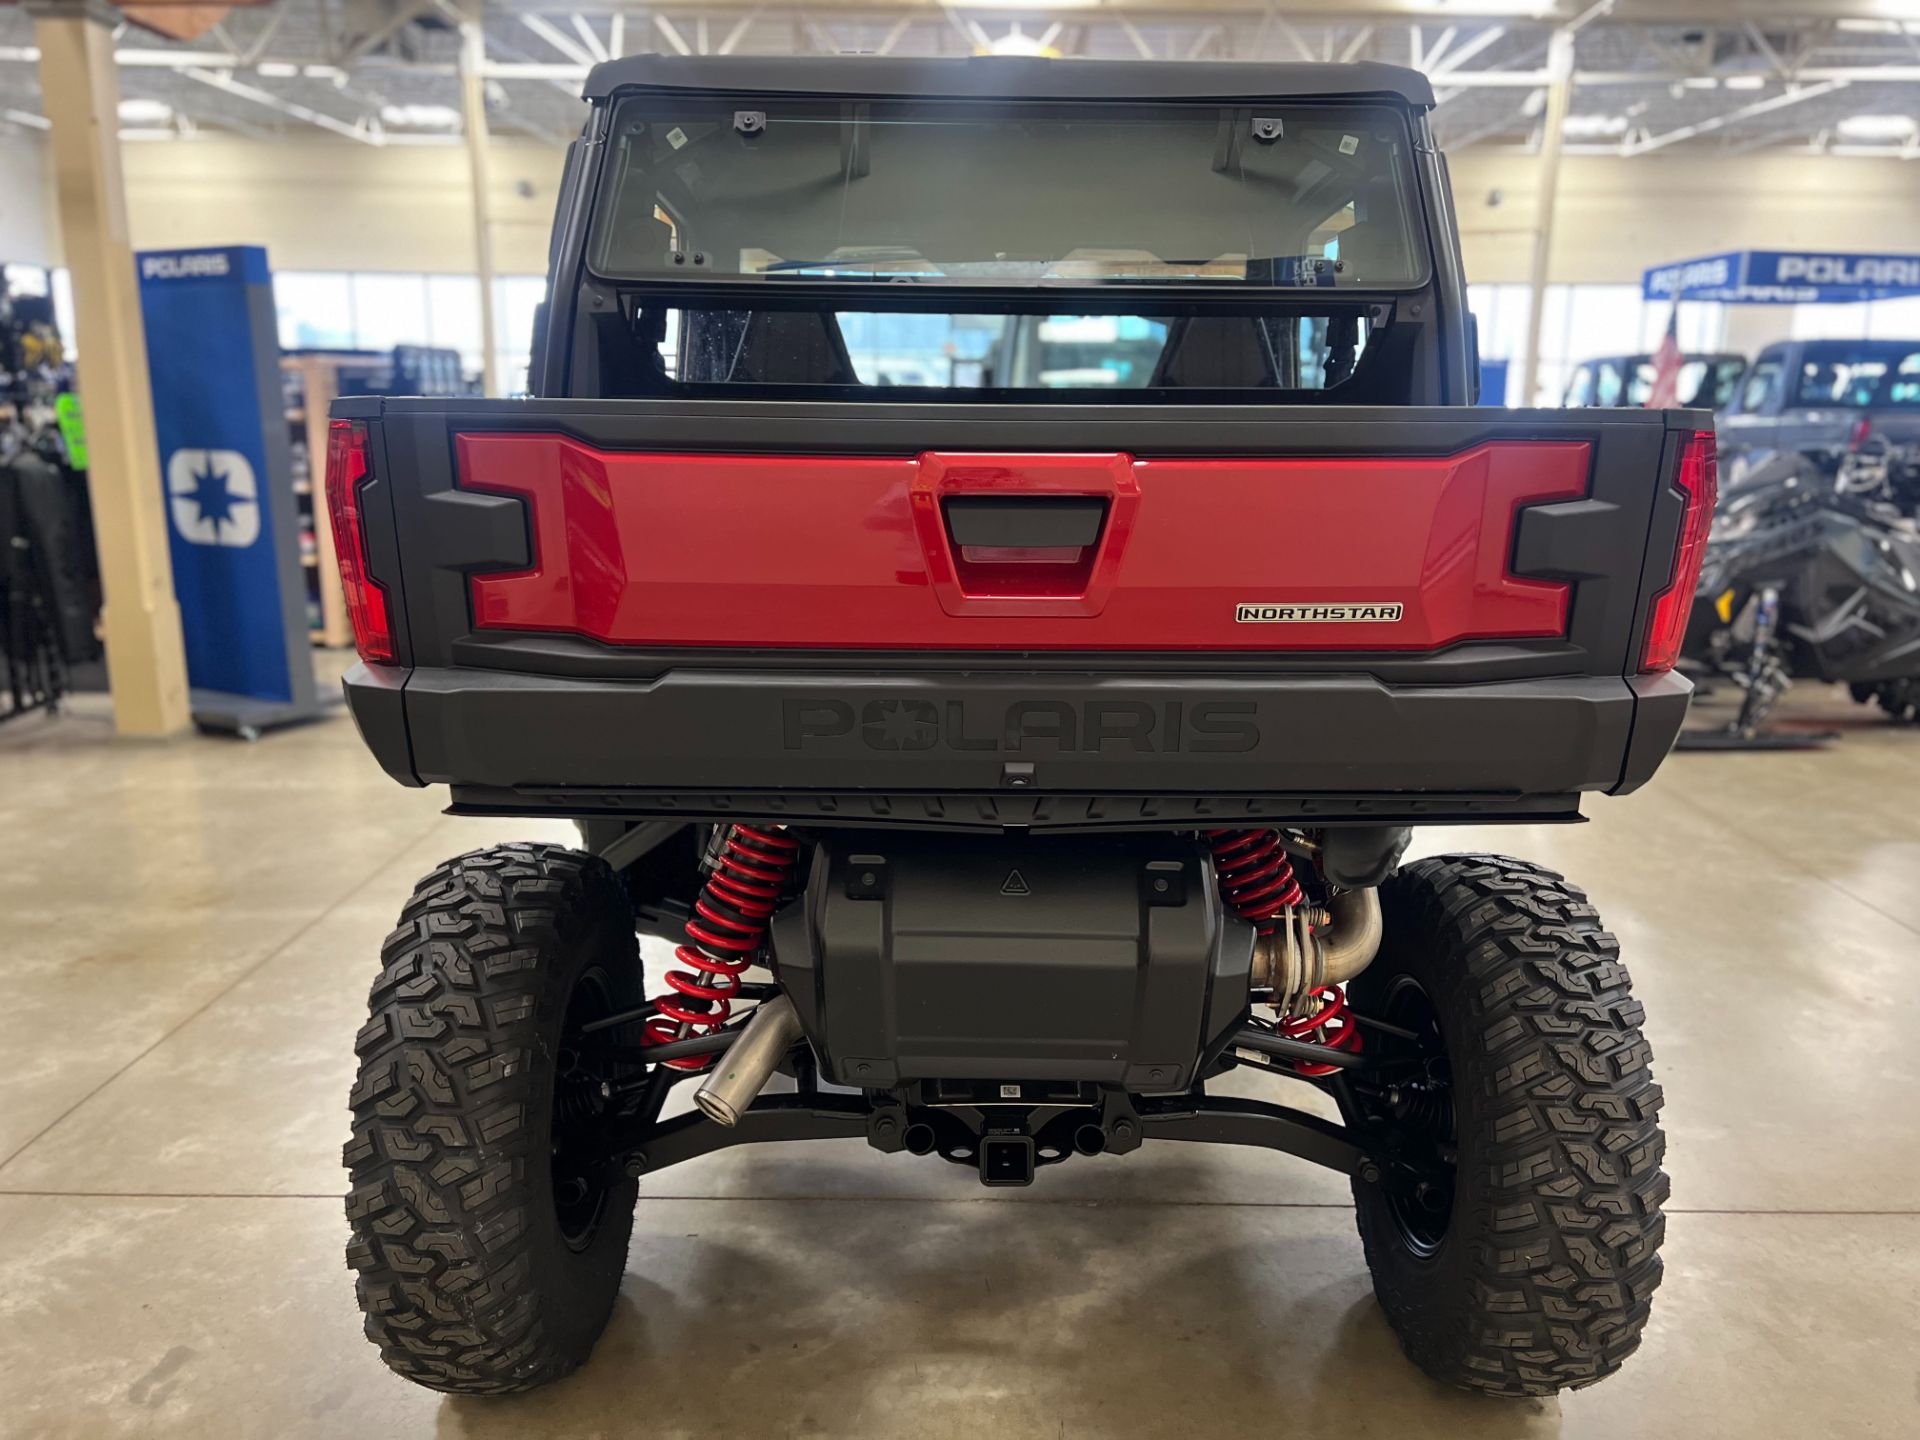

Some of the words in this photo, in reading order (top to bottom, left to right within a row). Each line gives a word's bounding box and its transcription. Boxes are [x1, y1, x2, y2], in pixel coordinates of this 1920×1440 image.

[143, 253, 229, 279] POLARIS
[1243, 607, 1395, 619] NORTHSTAR
[782, 699, 1261, 753] POLARIS
